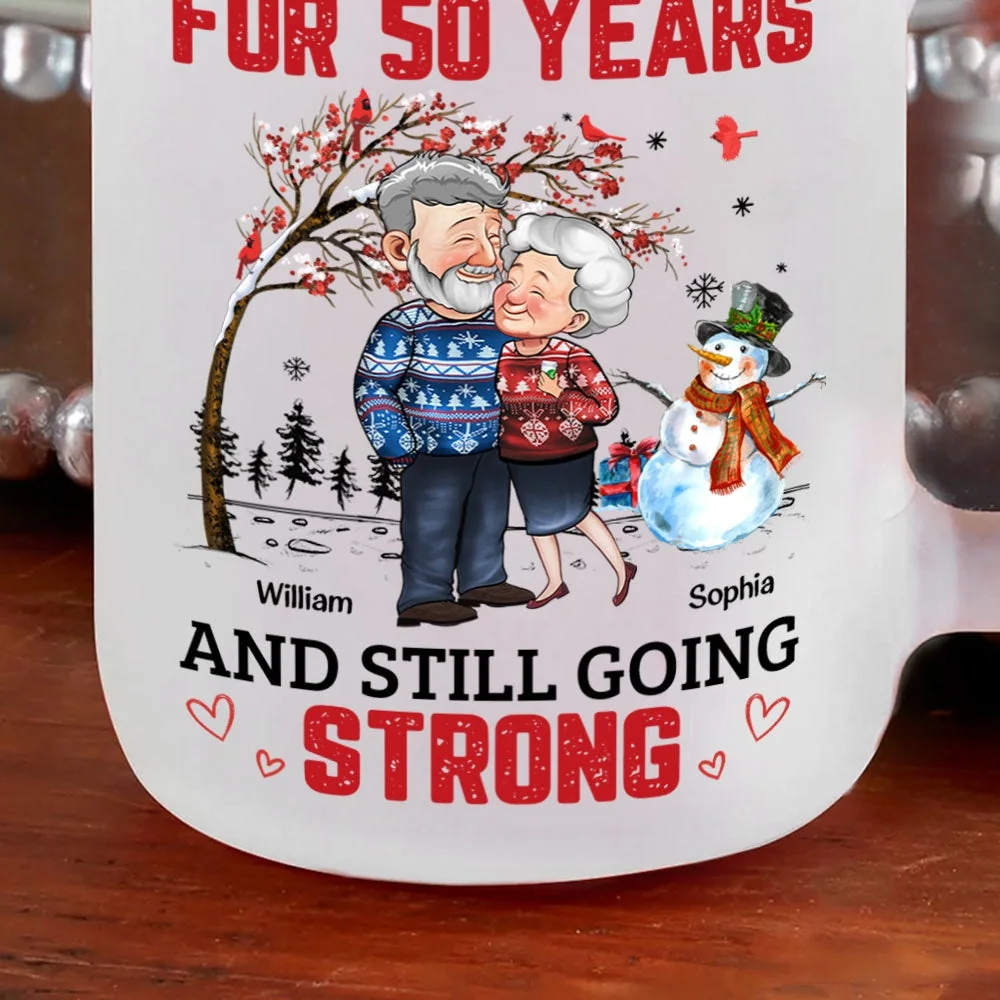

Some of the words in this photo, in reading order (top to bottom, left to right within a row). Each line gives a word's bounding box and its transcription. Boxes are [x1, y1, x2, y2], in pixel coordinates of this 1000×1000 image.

[256, 579, 353, 615] William
[688, 572, 775, 612] Sophia
[179, 620, 339, 692] AND
[361, 644, 557, 702] STILL
[577, 615, 799, 699] GOING
[303, 704, 681, 805] STRONG
